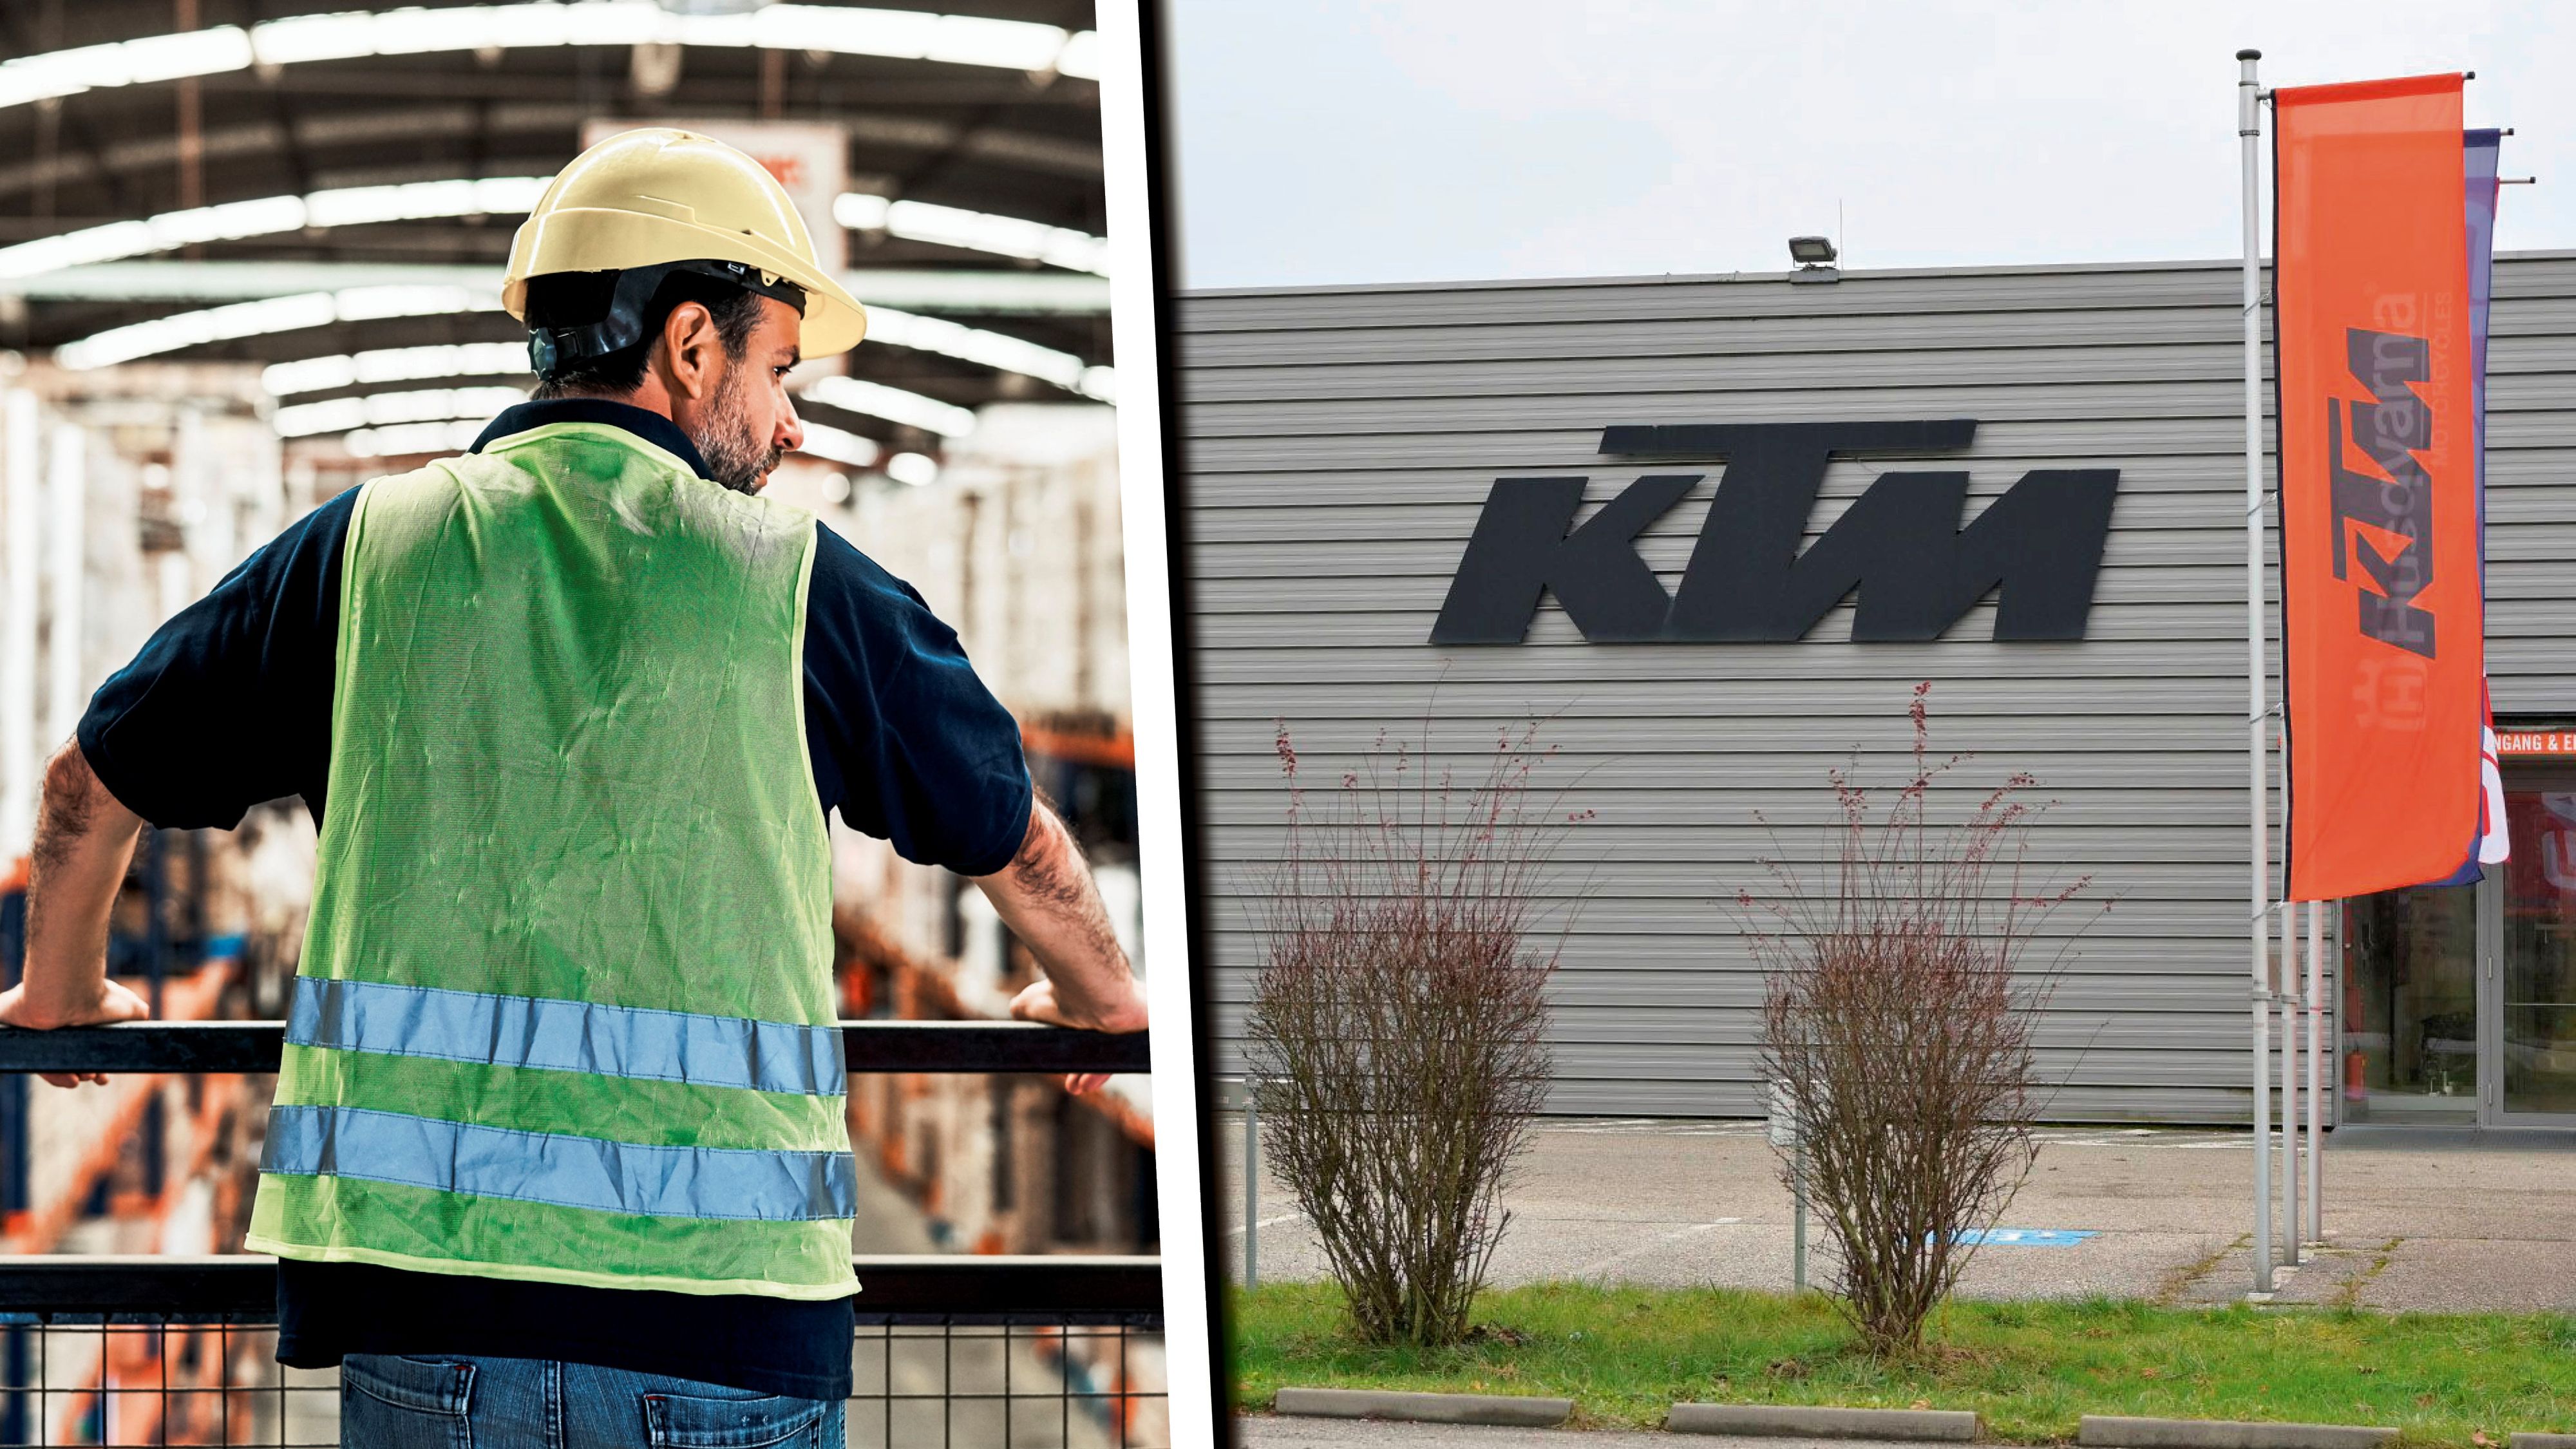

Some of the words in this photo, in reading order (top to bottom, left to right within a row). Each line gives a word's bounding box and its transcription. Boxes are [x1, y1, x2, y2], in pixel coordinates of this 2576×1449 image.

[1428, 419, 2120, 643] KTM
[2327, 327, 2436, 659] KTM
[2548, 734, 2558, 750] &
